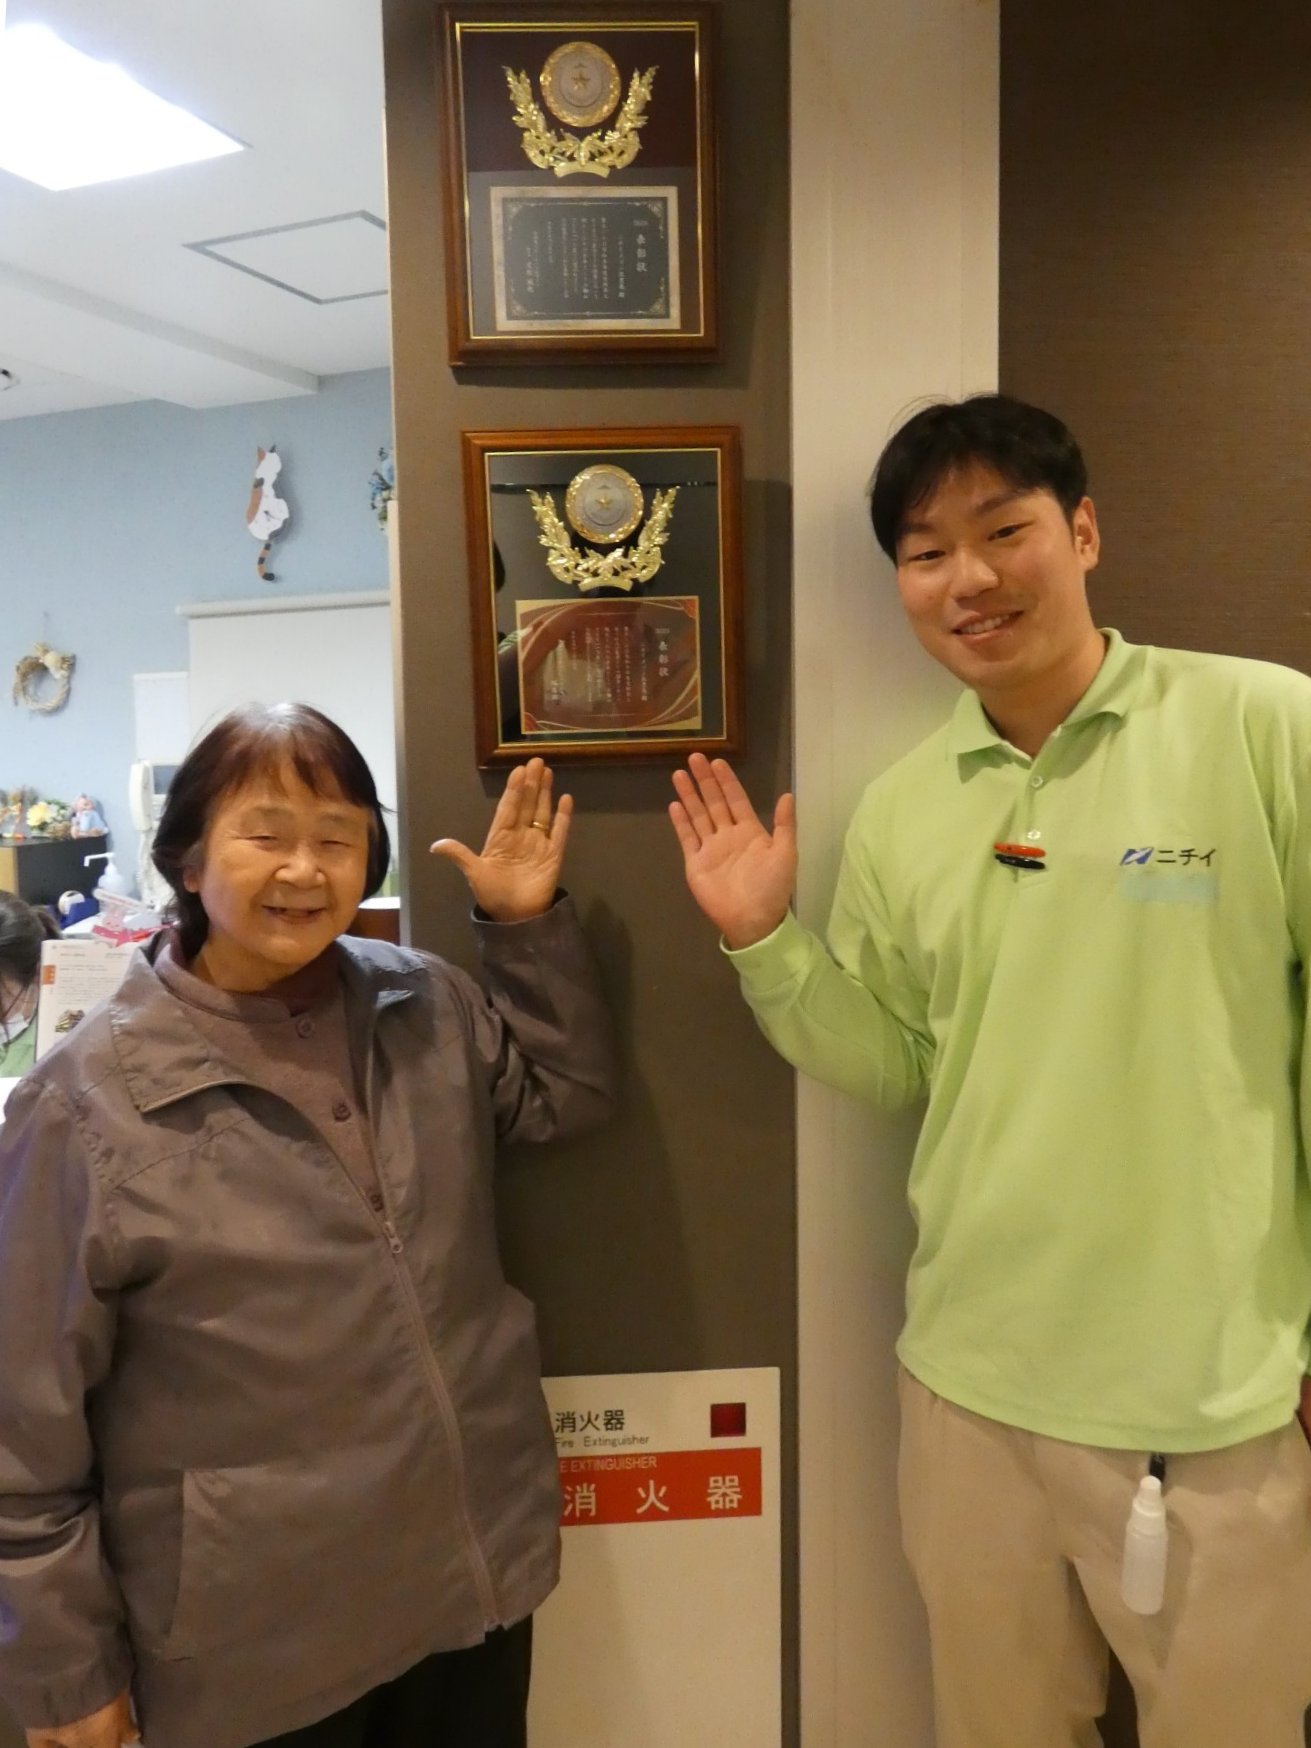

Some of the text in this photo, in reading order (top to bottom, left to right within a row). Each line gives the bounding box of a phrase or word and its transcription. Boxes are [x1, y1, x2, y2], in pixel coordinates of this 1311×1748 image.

[1156, 848, 1217, 867] ニチイ
[555, 1409, 625, 1433] 消火器
[583, 1434, 650, 1449] Extinguisher
[571, 1456, 657, 1472] EXTINGUISHER
